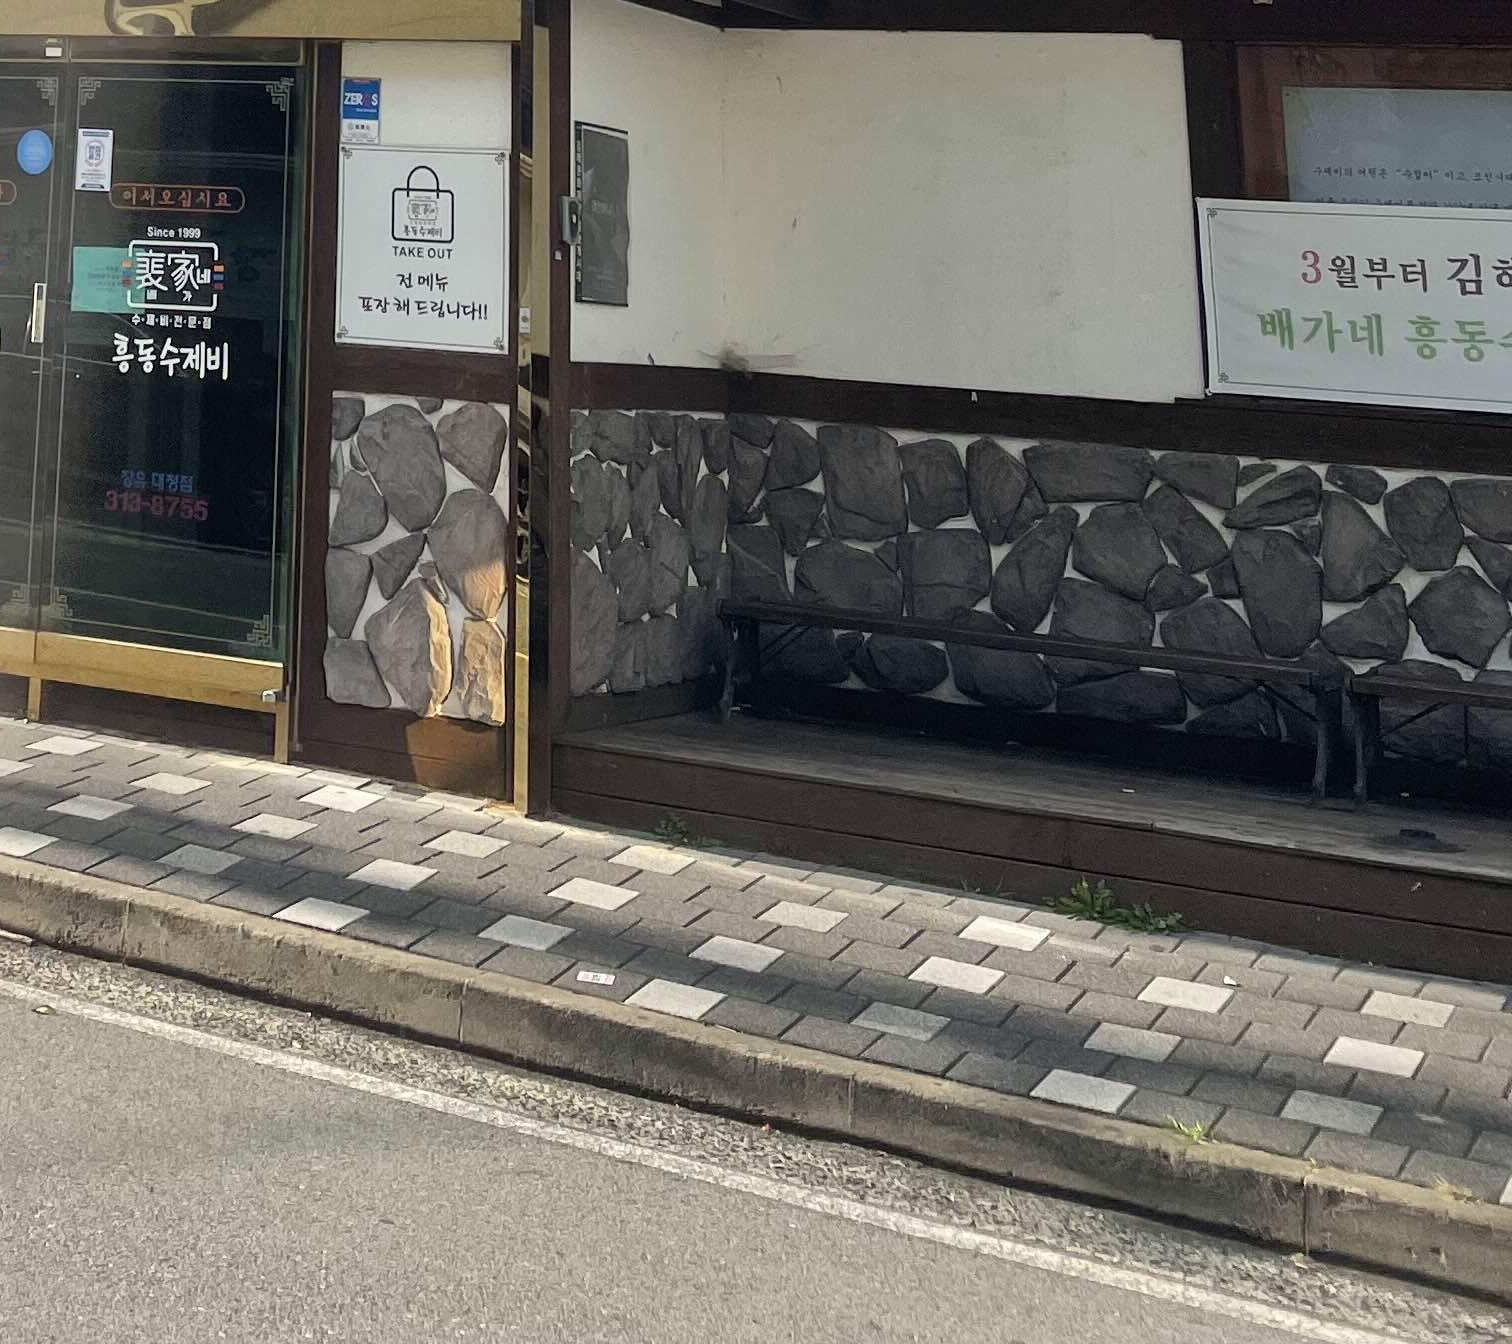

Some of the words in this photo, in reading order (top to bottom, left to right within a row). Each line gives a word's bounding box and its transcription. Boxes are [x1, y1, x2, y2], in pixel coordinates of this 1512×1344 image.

[147, 226, 175, 238] Since
[178, 227, 201, 239] 1999
[392, 246, 424, 258] TAKE
[427, 248, 453, 259] OUT
[396, 273, 413, 288] 전
[418, 273, 448, 292] 메뉴
[1301, 250, 1428, 293] 3월부터
[358, 296, 390, 313] 포장
[393, 297, 410, 316] 해
[414, 300, 488, 320] 드립니다!!
[1257, 308, 1384, 357] 배가네
[111, 332, 229, 381] 흥동수제비
